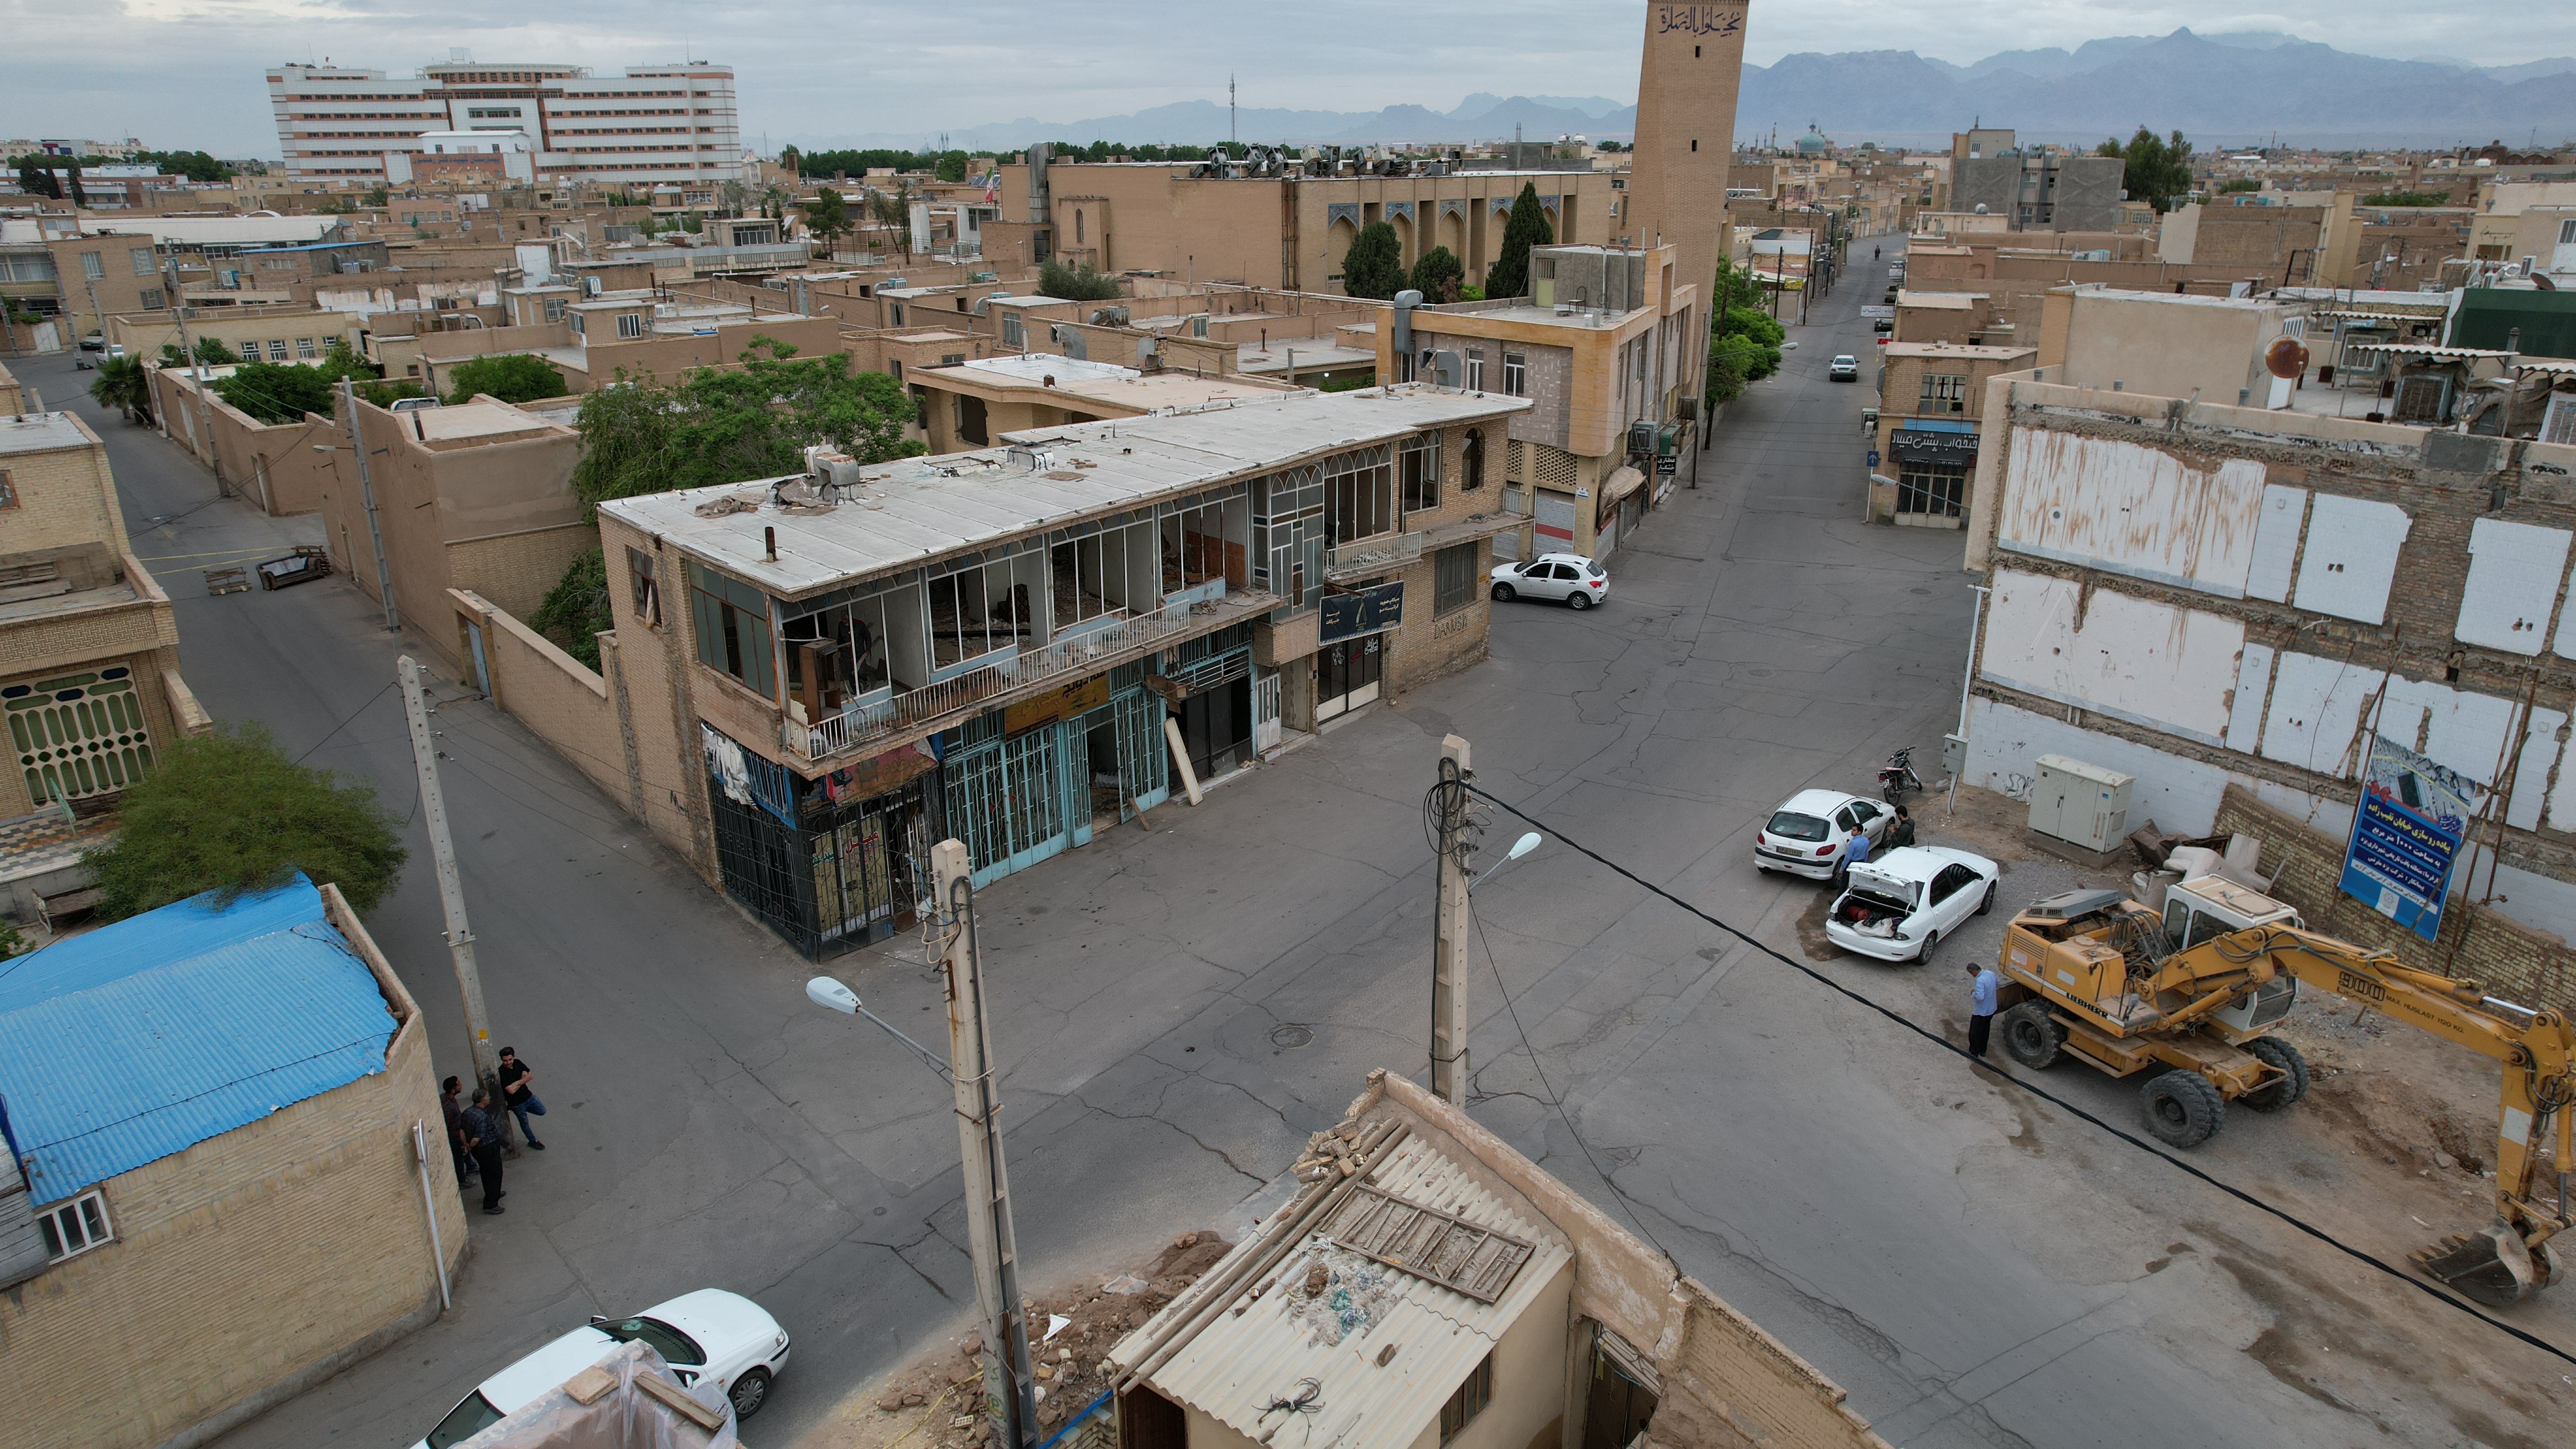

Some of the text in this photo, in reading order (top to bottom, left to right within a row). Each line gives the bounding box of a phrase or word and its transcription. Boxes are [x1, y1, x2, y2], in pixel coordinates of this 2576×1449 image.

[2393, 817, 2412, 831] خیابان
[2385, 834, 2395, 842] متر
[2413, 849, 2433, 863] مساحت
[2338, 971, 2386, 1002] 900
[2066, 991, 2109, 1019] LIEBHERR
[2337, 986, 2383, 1010] Litronic
[2386, 994, 2401, 1006] MAX.
